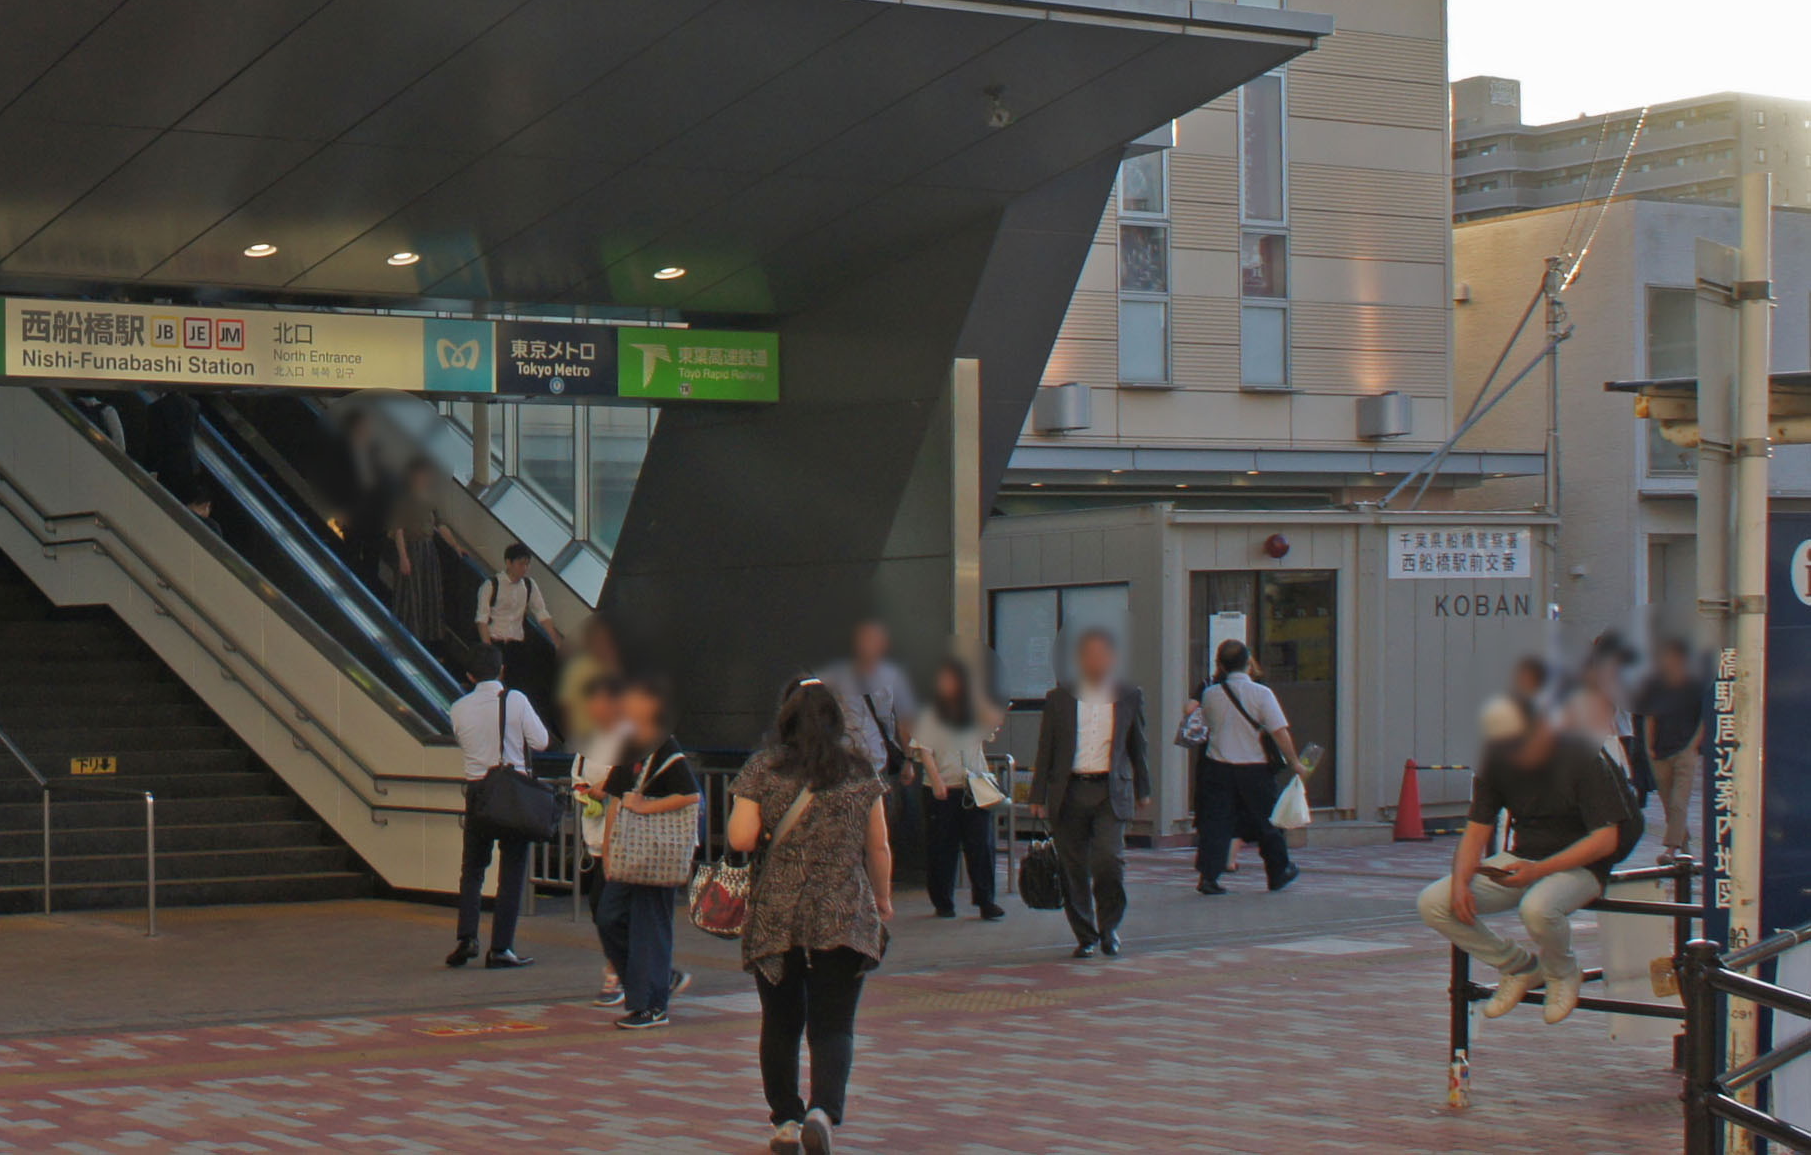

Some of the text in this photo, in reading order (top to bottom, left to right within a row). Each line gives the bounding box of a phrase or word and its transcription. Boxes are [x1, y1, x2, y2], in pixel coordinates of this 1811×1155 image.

[21, 310, 241, 347] 西船橋駅 JB JE JM
[273, 322, 312, 344] 北口
[273, 349, 362, 364] North Entrance
[510, 339, 596, 361] 東京メトロ
[22, 349, 255, 376] Nishi-Funabashi Station
[516, 361, 590, 379] Tokyo Metro
[1402, 553, 1517, 572] 西船橋駅前交番
[1435, 595, 1529, 616] KOBAN
